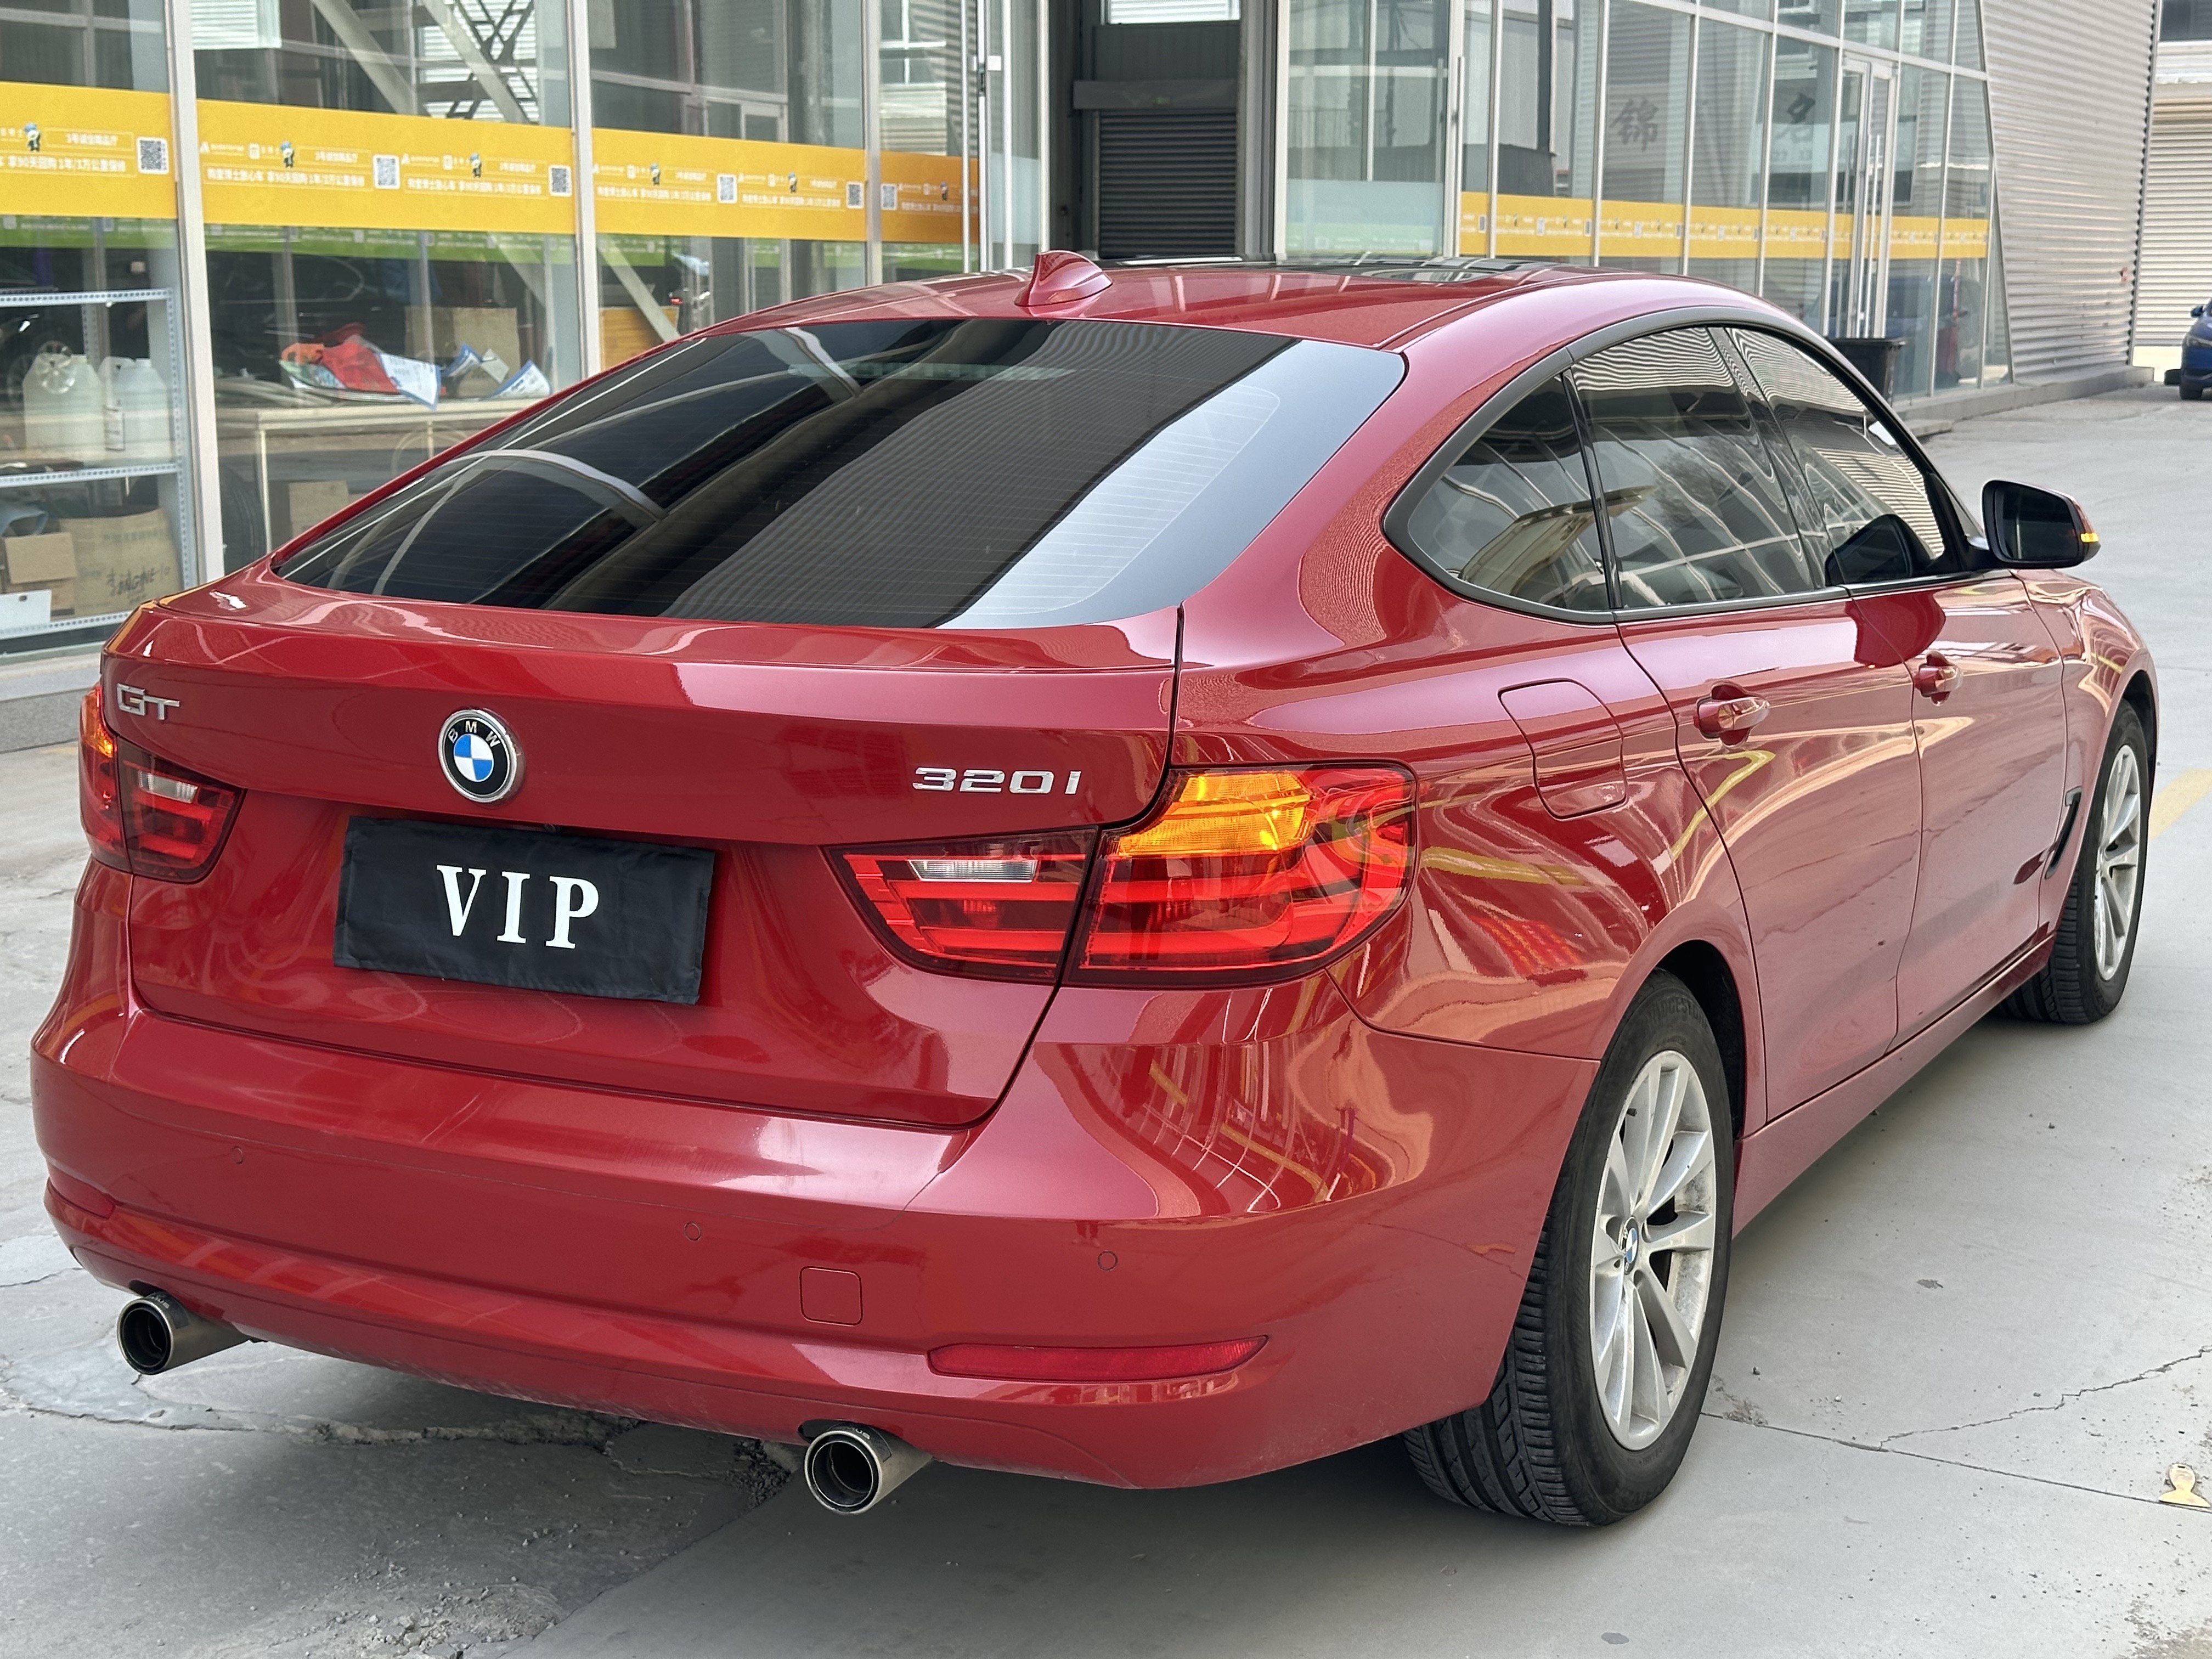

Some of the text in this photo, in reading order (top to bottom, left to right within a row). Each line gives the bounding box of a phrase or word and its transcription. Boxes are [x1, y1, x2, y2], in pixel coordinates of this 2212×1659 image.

[116, 683, 180, 720] GT
[448, 720, 500, 748] BMW
[437, 864, 599, 949] VIP
